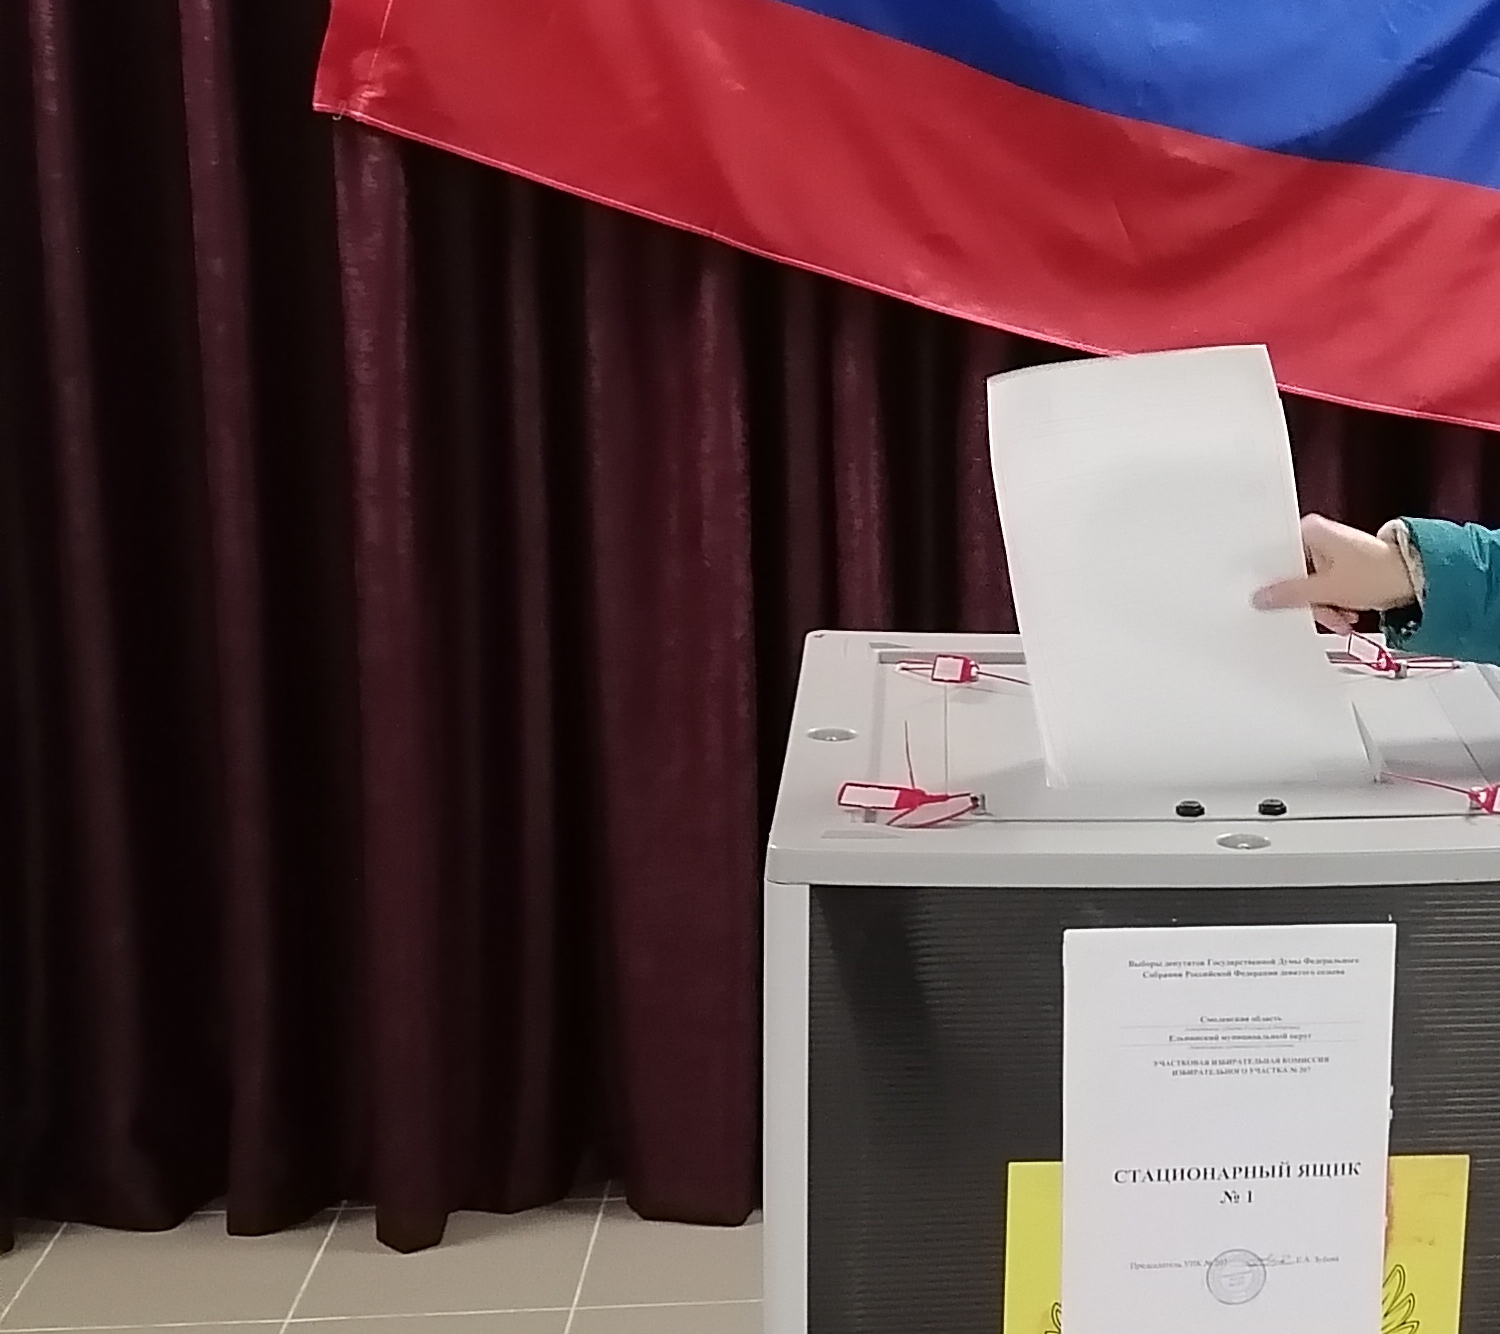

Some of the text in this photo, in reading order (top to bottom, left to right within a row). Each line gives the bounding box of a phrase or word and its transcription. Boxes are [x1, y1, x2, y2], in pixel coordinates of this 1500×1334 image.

[1200, 1015, 1249, 1023] Смоленская
[1289, 1033, 1312, 1041] округ
[1153, 1056, 1330, 1067] УЧАСТКОВАЯ ИЗБИРАТЕЛЬНАЯ КОМИССИЯ
[1171, 1068, 1248, 1077] ИЗБИРАТЕЛЬНОГО
[1249, 1067, 1288, 1075] УЧАСТКА
[1114, 1161, 1362, 1184] СТАЦИОНАРНЫЙ ЯЩИК
[1219, 1190, 1253, 1204] № 1
